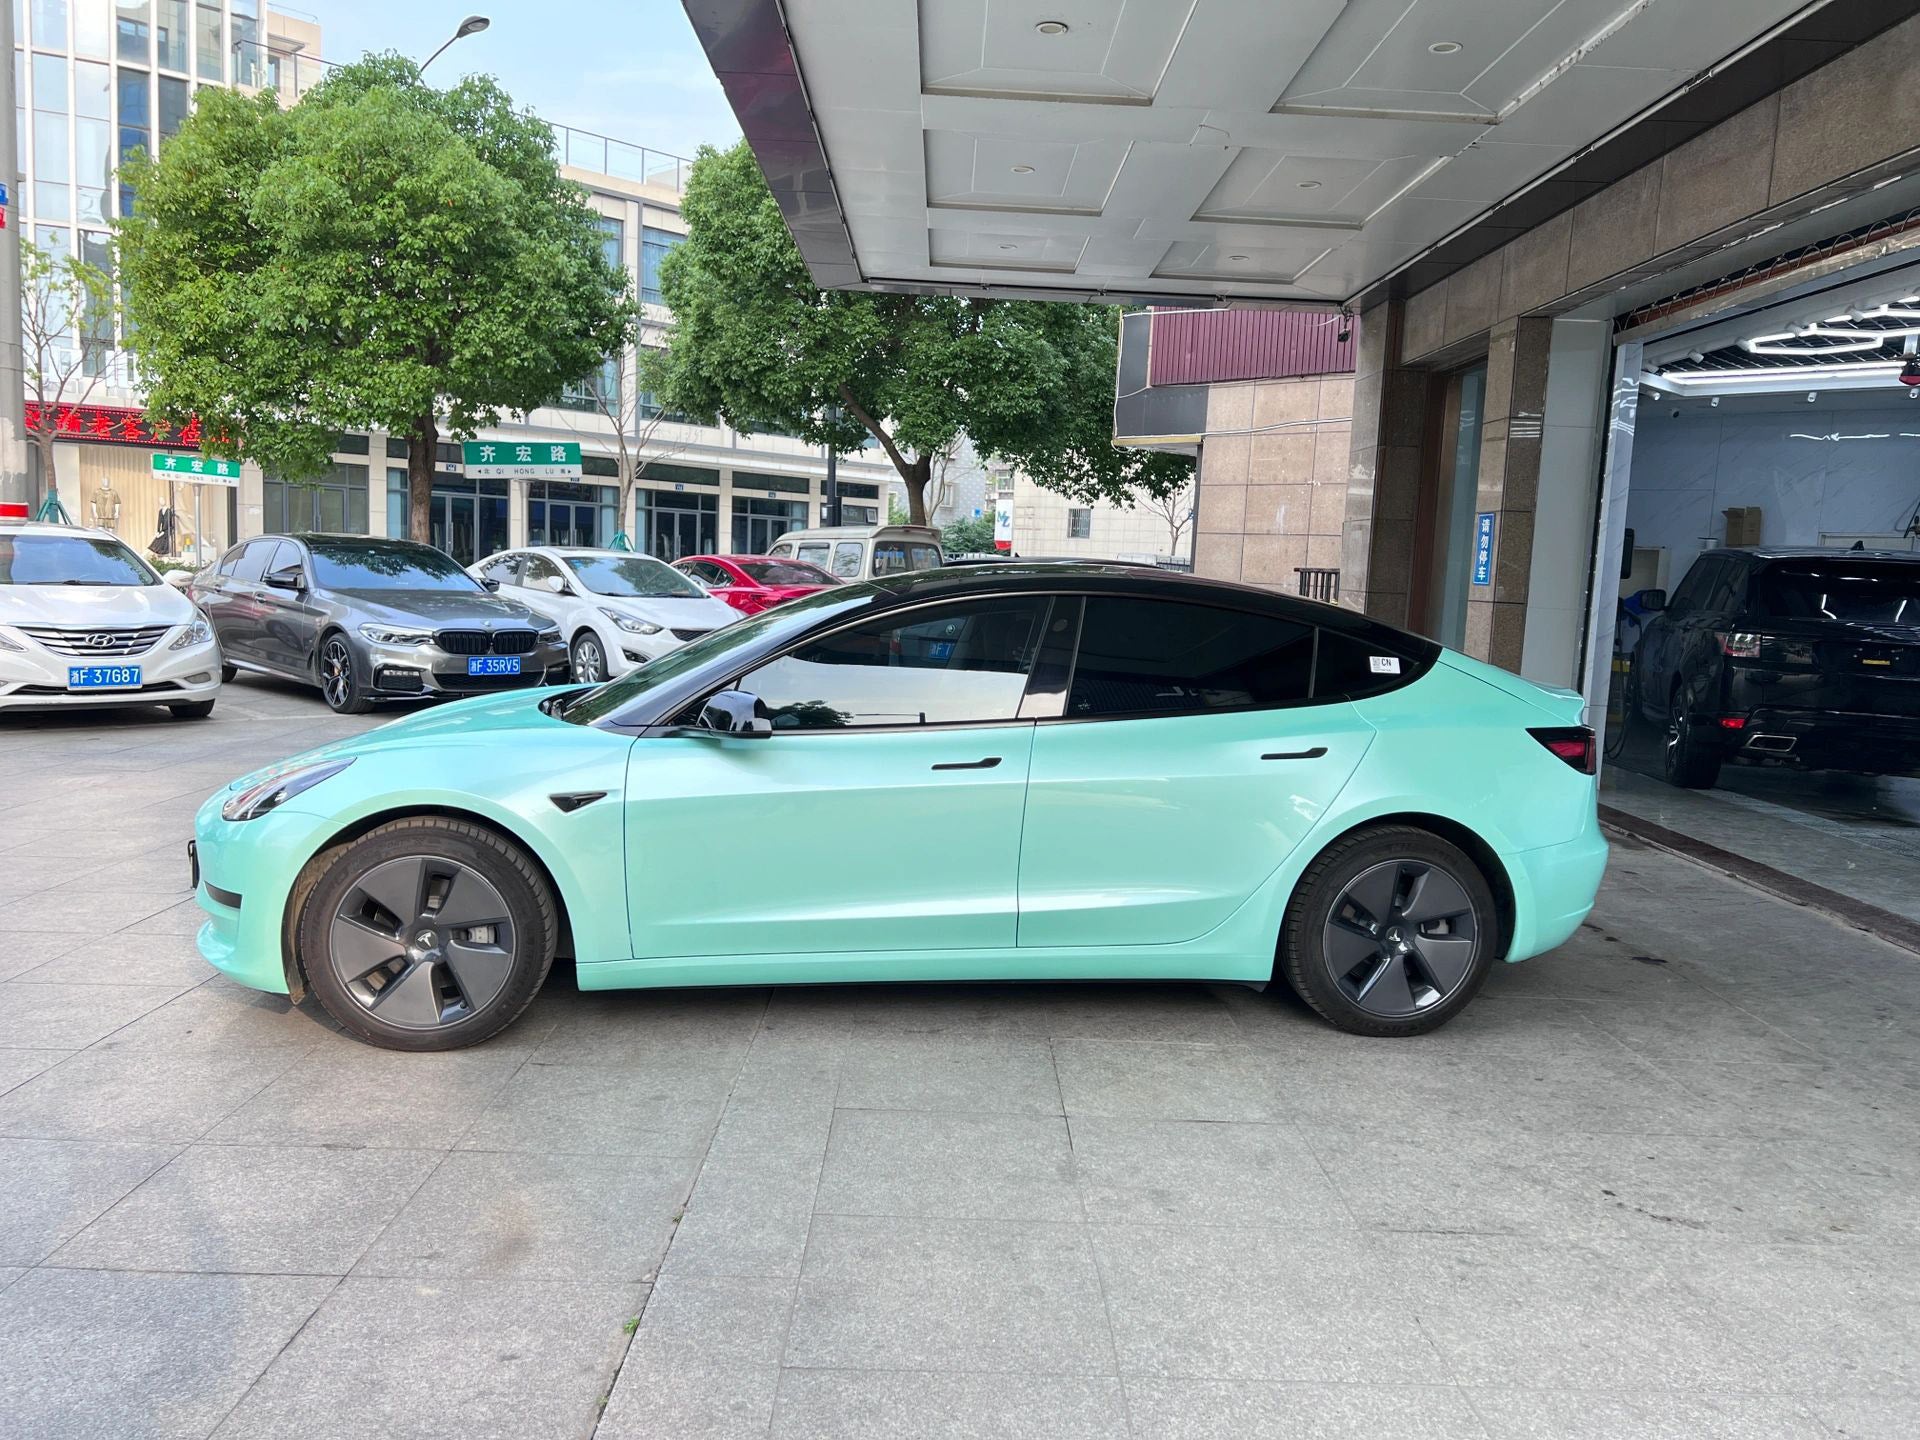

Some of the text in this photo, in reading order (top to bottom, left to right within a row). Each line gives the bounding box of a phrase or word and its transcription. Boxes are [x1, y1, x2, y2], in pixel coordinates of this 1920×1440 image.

[479, 445, 567, 462] 齐宏路
[164, 457, 229, 475] 齐宏路
[1477, 518, 1491, 581] 请勿停车
